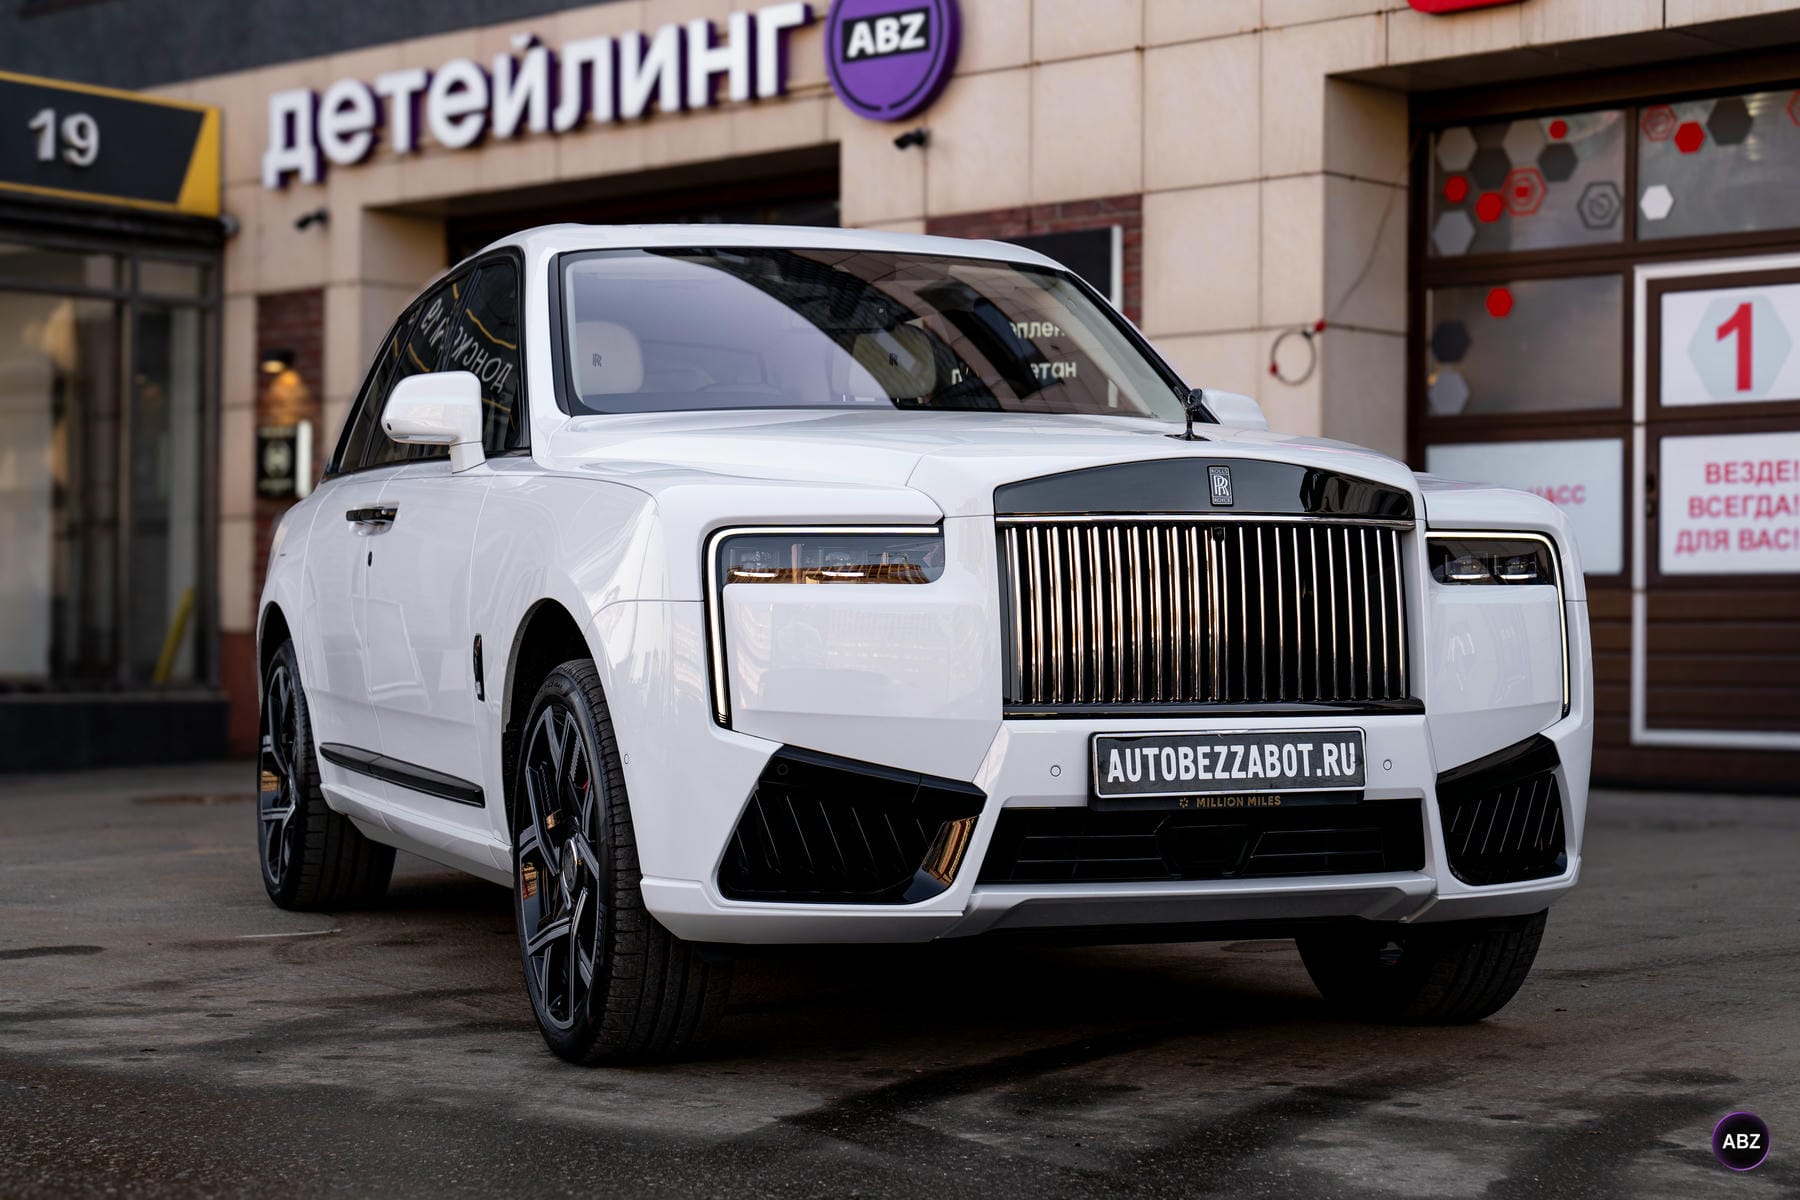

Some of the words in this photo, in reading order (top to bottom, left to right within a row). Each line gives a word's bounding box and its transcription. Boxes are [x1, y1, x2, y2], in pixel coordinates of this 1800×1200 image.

[846, 12, 927, 59] ABZ
[262, 2, 804, 190] детейлинг
[28, 107, 99, 167] 19
[1716, 302, 1753, 392] 1
[1704, 459, 1800, 487] ВЕЗДЕ!
[1688, 494, 1800, 521] ВСЕГДА!
[1674, 529, 1730, 555] ДЛЯ
[1738, 528, 1800, 551] ВАС!
[1107, 742, 1356, 783] AUTOBEZZABOT.RU
[1196, 797, 1244, 808] MILLION
[1247, 795, 1282, 807] MILES
